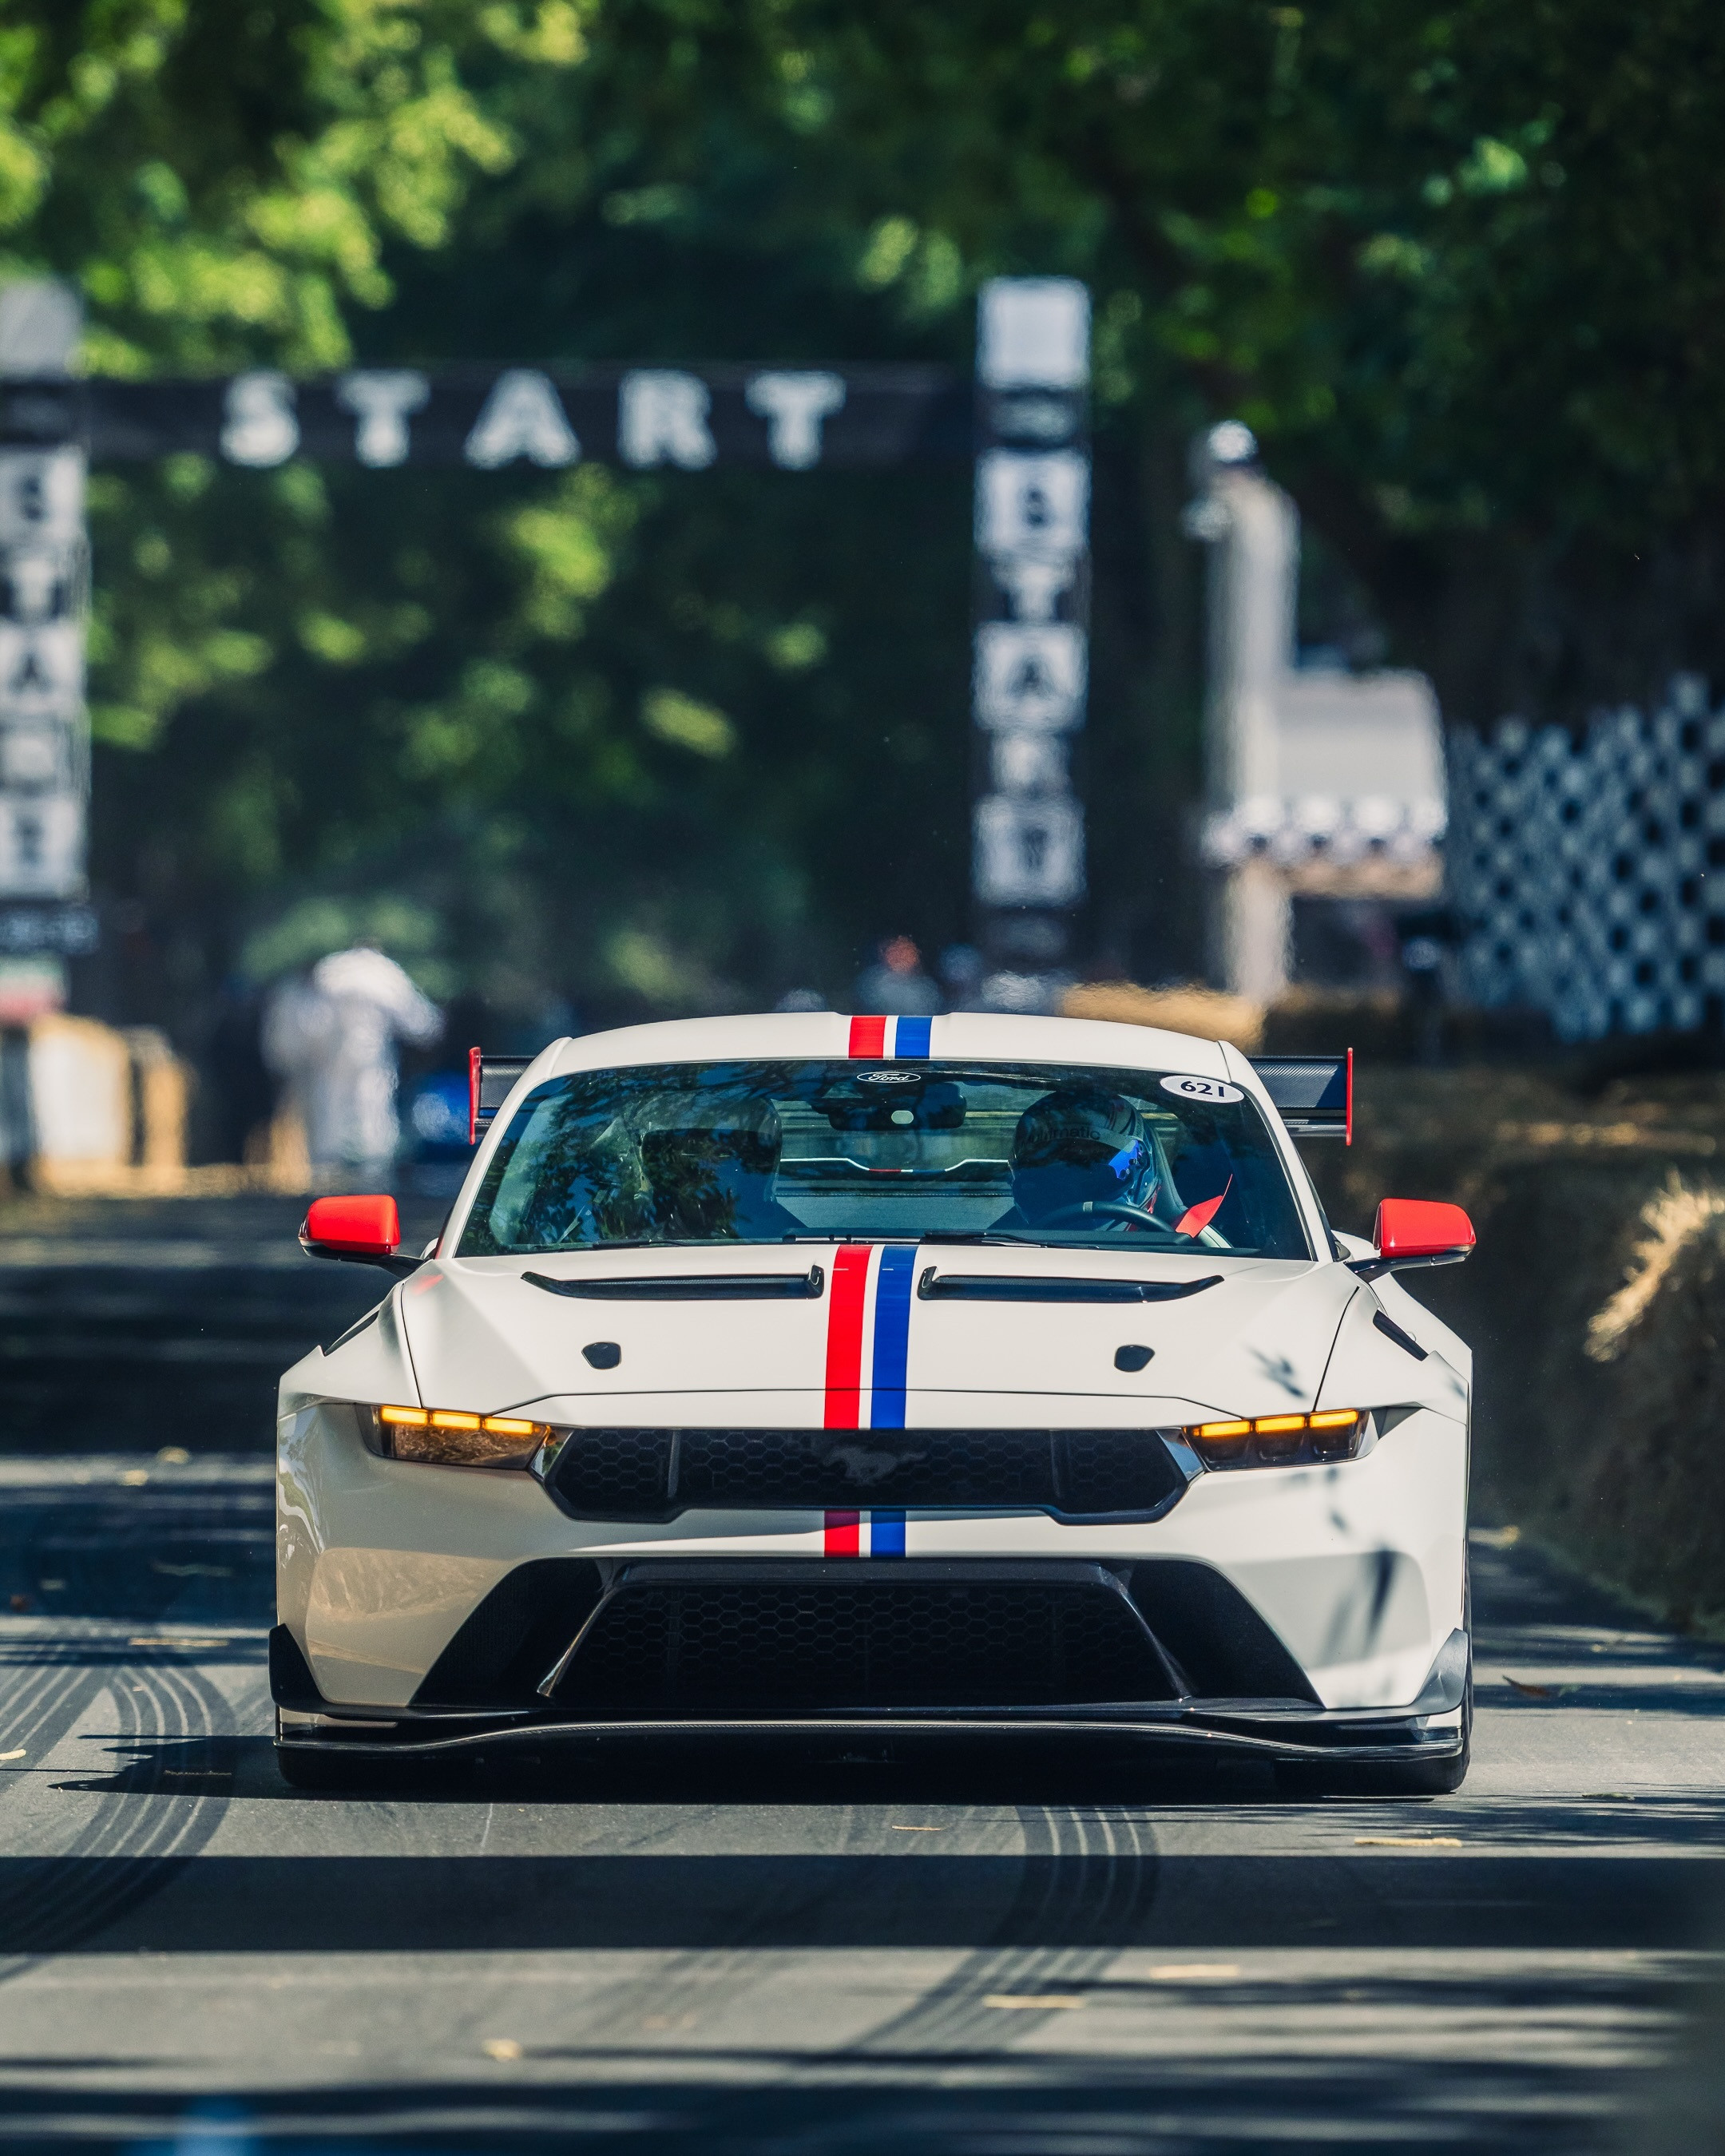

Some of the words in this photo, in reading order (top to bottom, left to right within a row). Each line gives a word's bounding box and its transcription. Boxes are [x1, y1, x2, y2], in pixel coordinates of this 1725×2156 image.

[220, 367, 847, 470] START
[867, 1072, 911, 1082] Ford
[1180, 1080, 1225, 1098] 621
